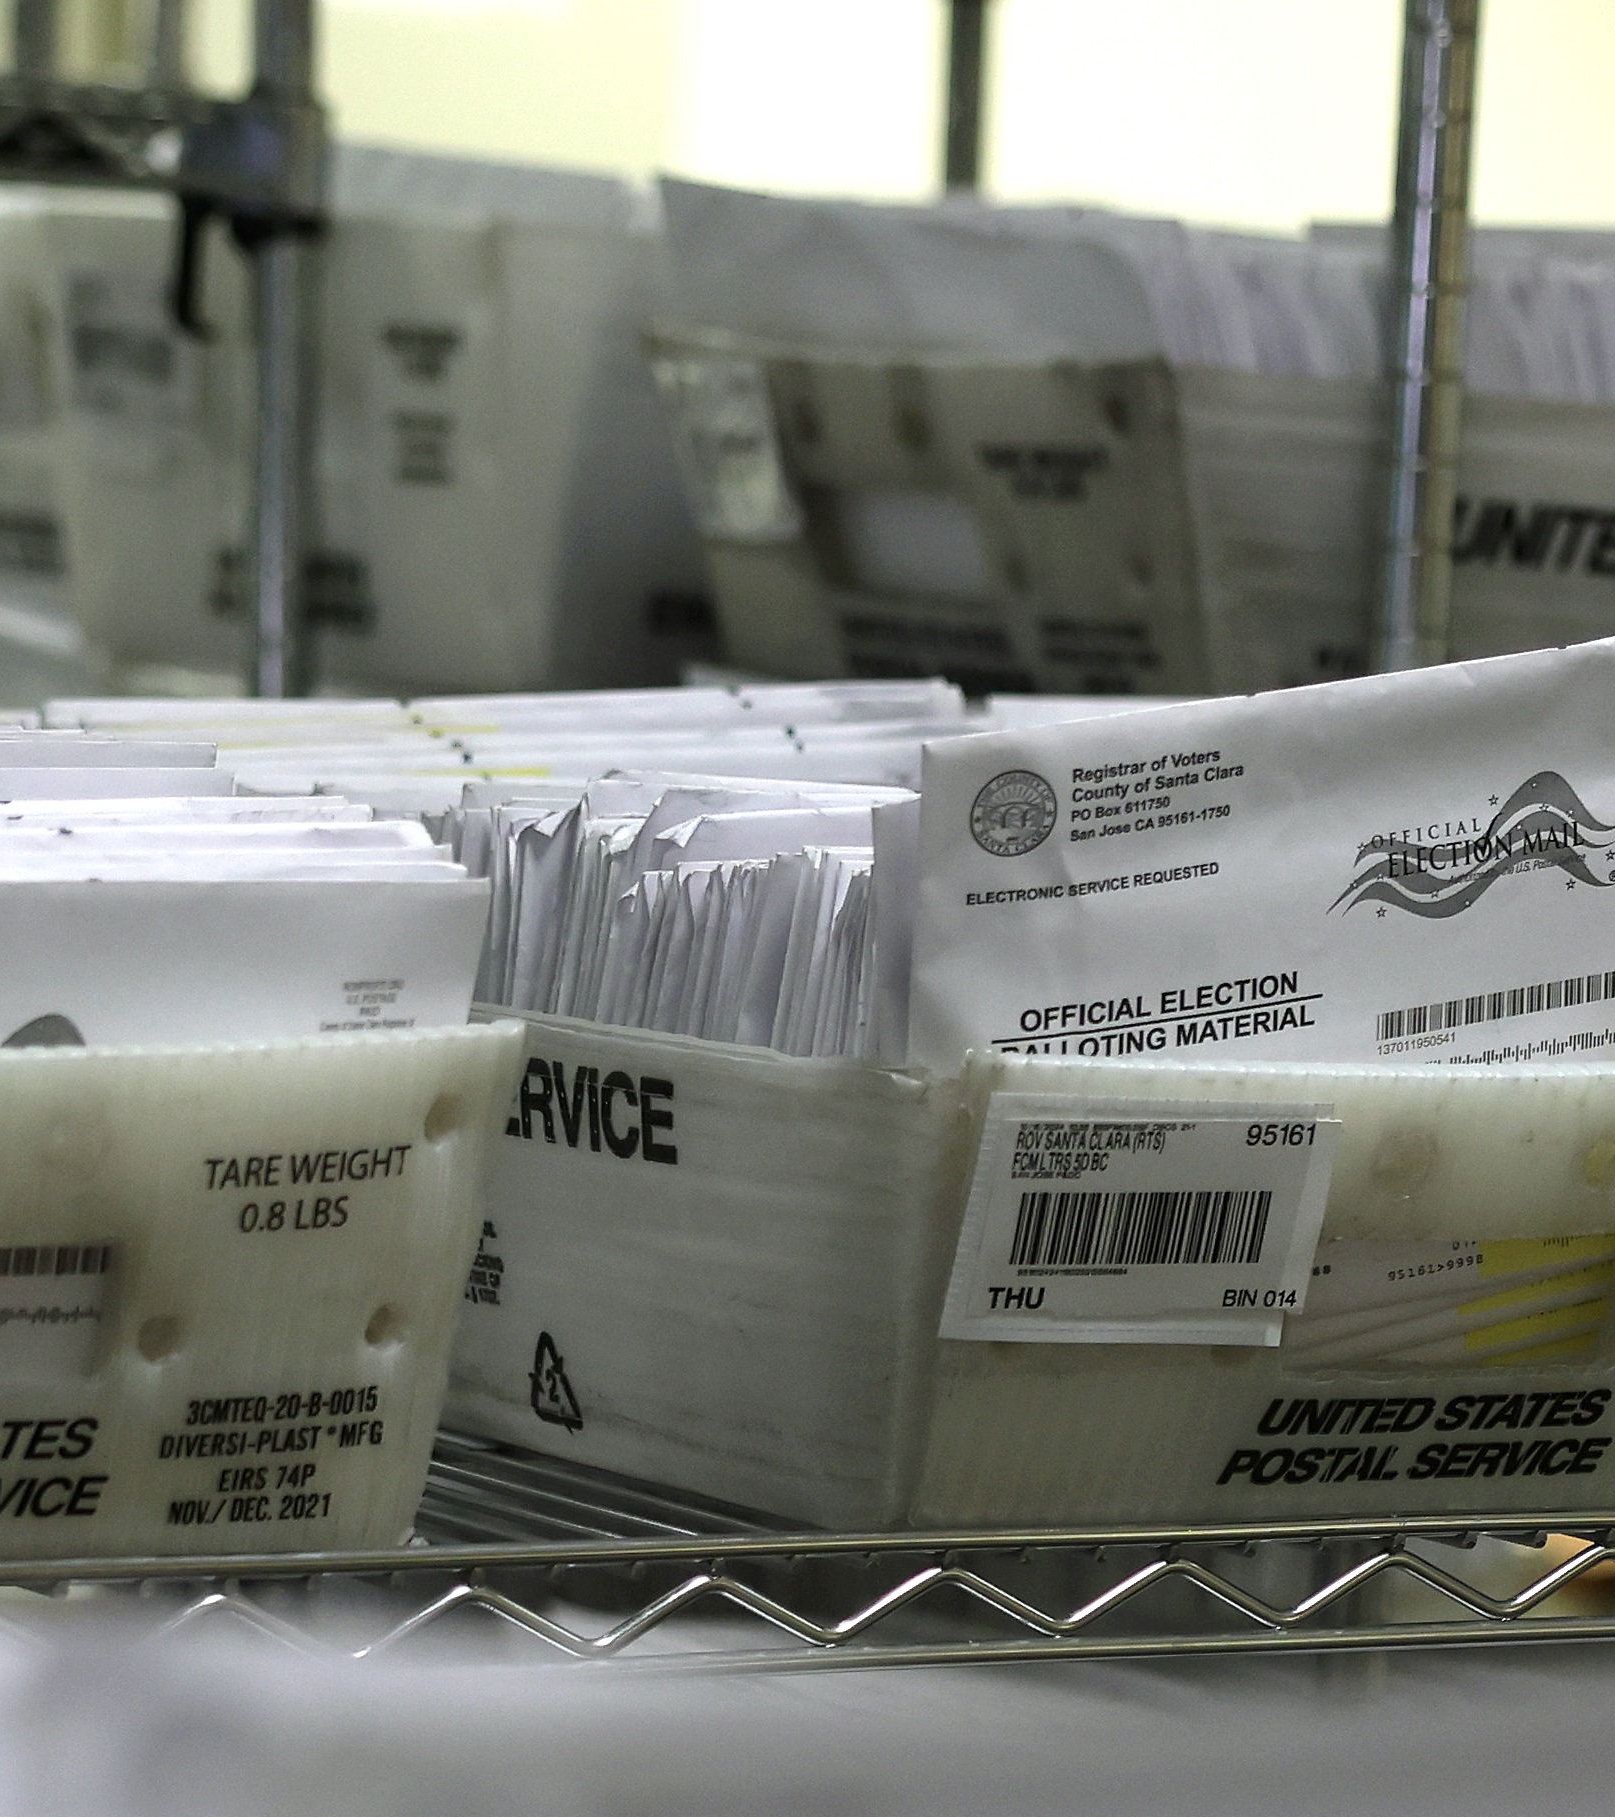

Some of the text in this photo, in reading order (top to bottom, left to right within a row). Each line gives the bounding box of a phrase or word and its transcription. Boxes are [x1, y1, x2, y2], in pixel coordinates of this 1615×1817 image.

[1072, 748, 1222, 787] Registrar of Voters
[1072, 763, 1245, 804] County of Santa Clara
[1070, 804, 1231, 843] San Jose CA 95161-1750
[1071, 796, 1171, 823] PO Box 611750
[1371, 817, 1482, 849] OFFICIAL
[1388, 828, 1513, 880] ELECTION
[1522, 820, 1586, 857] MAIL
[966, 861, 1220, 906] ELECTRONIC SERVICE REQUESTED
[1019, 971, 1298, 1033] OFFICIAL ELECTION
[1175, 1004, 1315, 1047] MATERIAL
[1376, 1031, 1457, 1056] 137011950541
[505, 1056, 678, 1165] RVICE
[1016, 1131, 1167, 1154] ROV SANTA CLARA (RTS)
[1245, 1123, 1318, 1148] 95161
[203, 1145, 411, 1190] TARE WEIGHT
[1091, 1152, 1110, 1171] BC
[239, 1197, 350, 1233] 0.8 LBS
[987, 1287, 1298, 1309] THU BIN 014
[1256, 1388, 1613, 1437] UNITED STATES
[158, 1420, 384, 1460] DIVERSI-PLAST MFG
[218, 1464, 316, 1493] EIRS 74P
[1215, 1436, 1614, 1486] POSTAL SERVICE
[228, 1497, 273, 1523] DEC.
[279, 1493, 332, 1520] 2021
